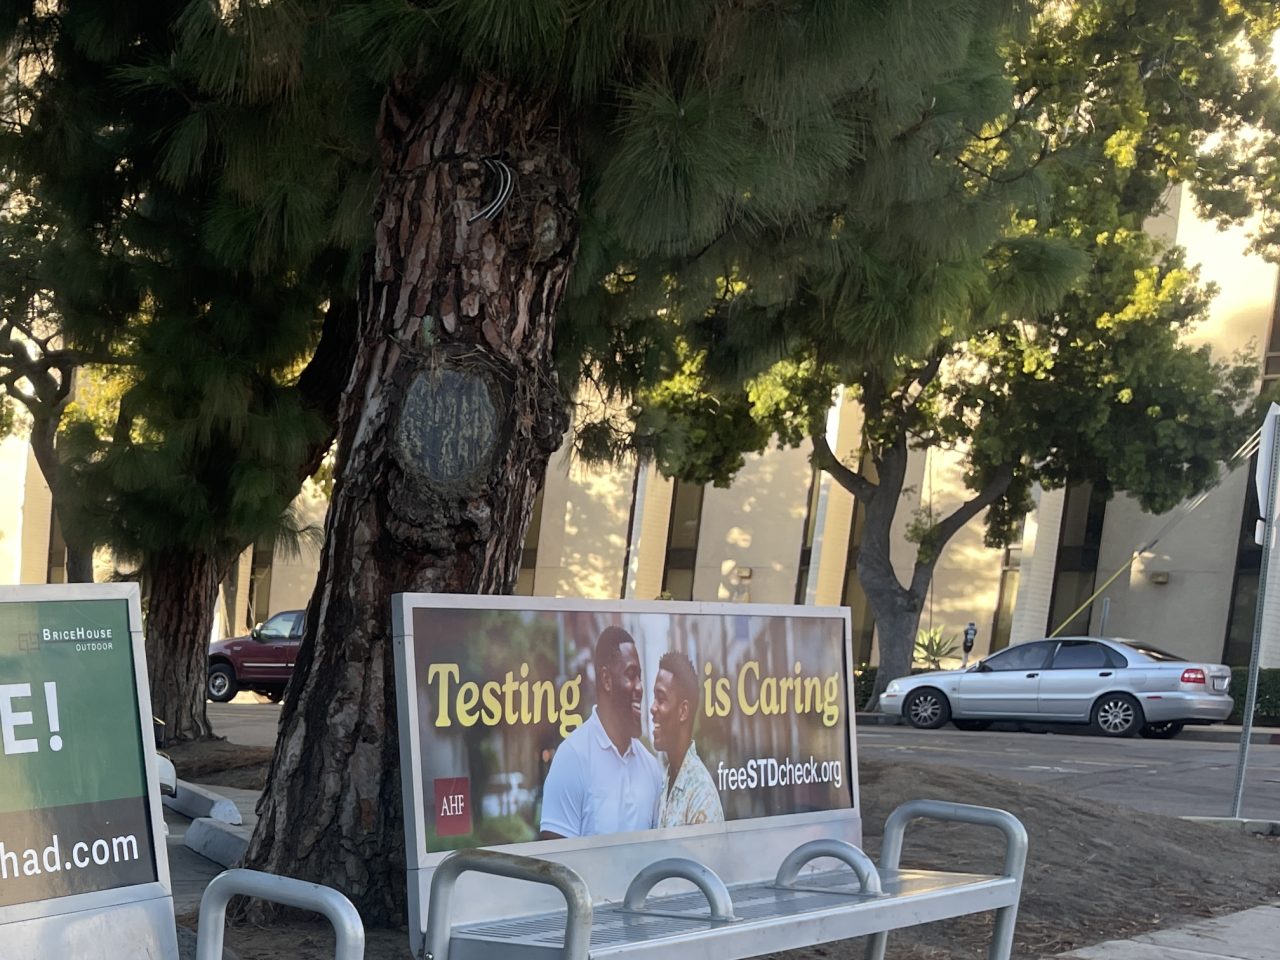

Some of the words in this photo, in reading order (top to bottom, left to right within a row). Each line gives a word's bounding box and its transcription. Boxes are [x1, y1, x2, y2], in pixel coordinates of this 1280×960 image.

[75, 642, 113, 652] OUTDOOR
[428, 662, 584, 738] Testing
[704, 661, 731, 718] is
[737, 660, 839, 727] Caring
[717, 755, 842, 791] freeSTDcheck.org
[440, 795, 465, 817] AHF
